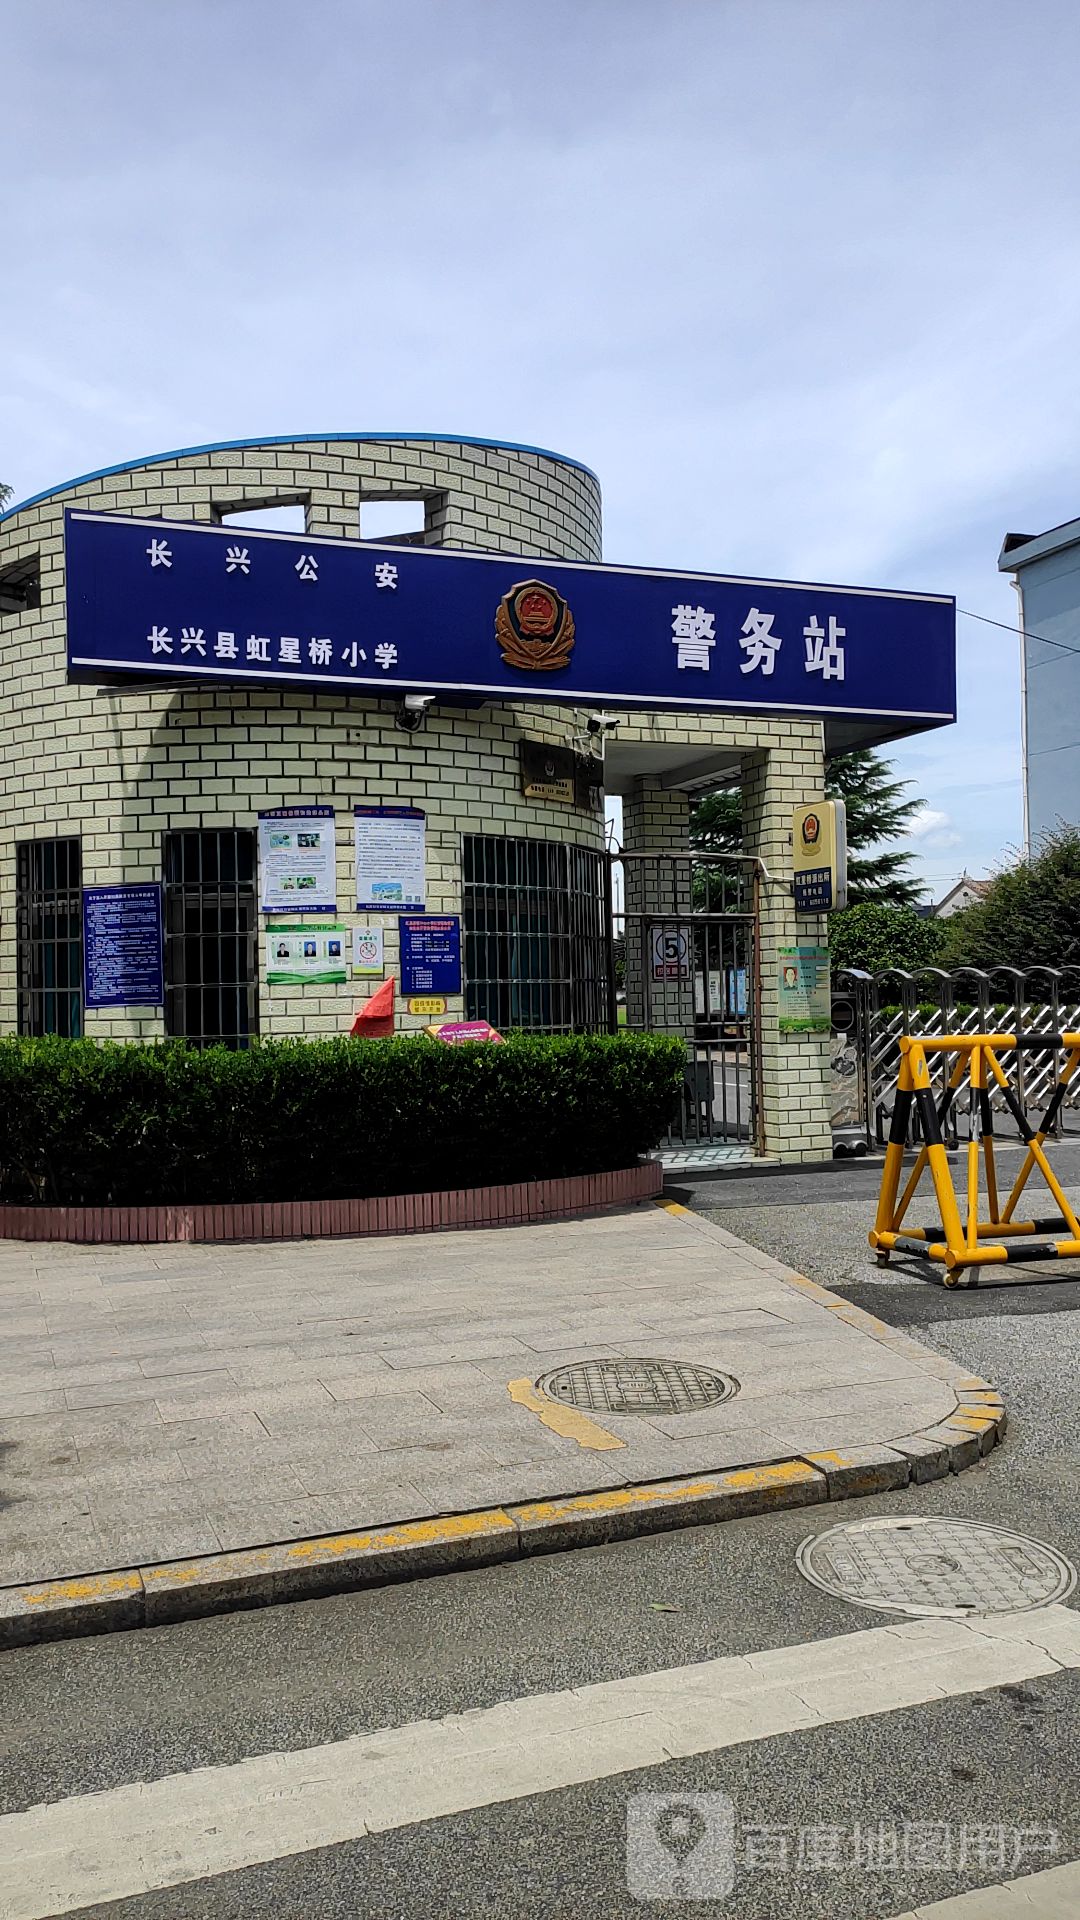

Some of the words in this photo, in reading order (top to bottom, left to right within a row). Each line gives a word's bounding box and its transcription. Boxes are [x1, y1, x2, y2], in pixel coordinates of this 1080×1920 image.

[147, 539, 398, 589] 长兴公安
[147, 626, 398, 671] 长兴县虹星桥小学
[671, 604, 847, 682] 警务站
[664, 938, 679, 958] 5
